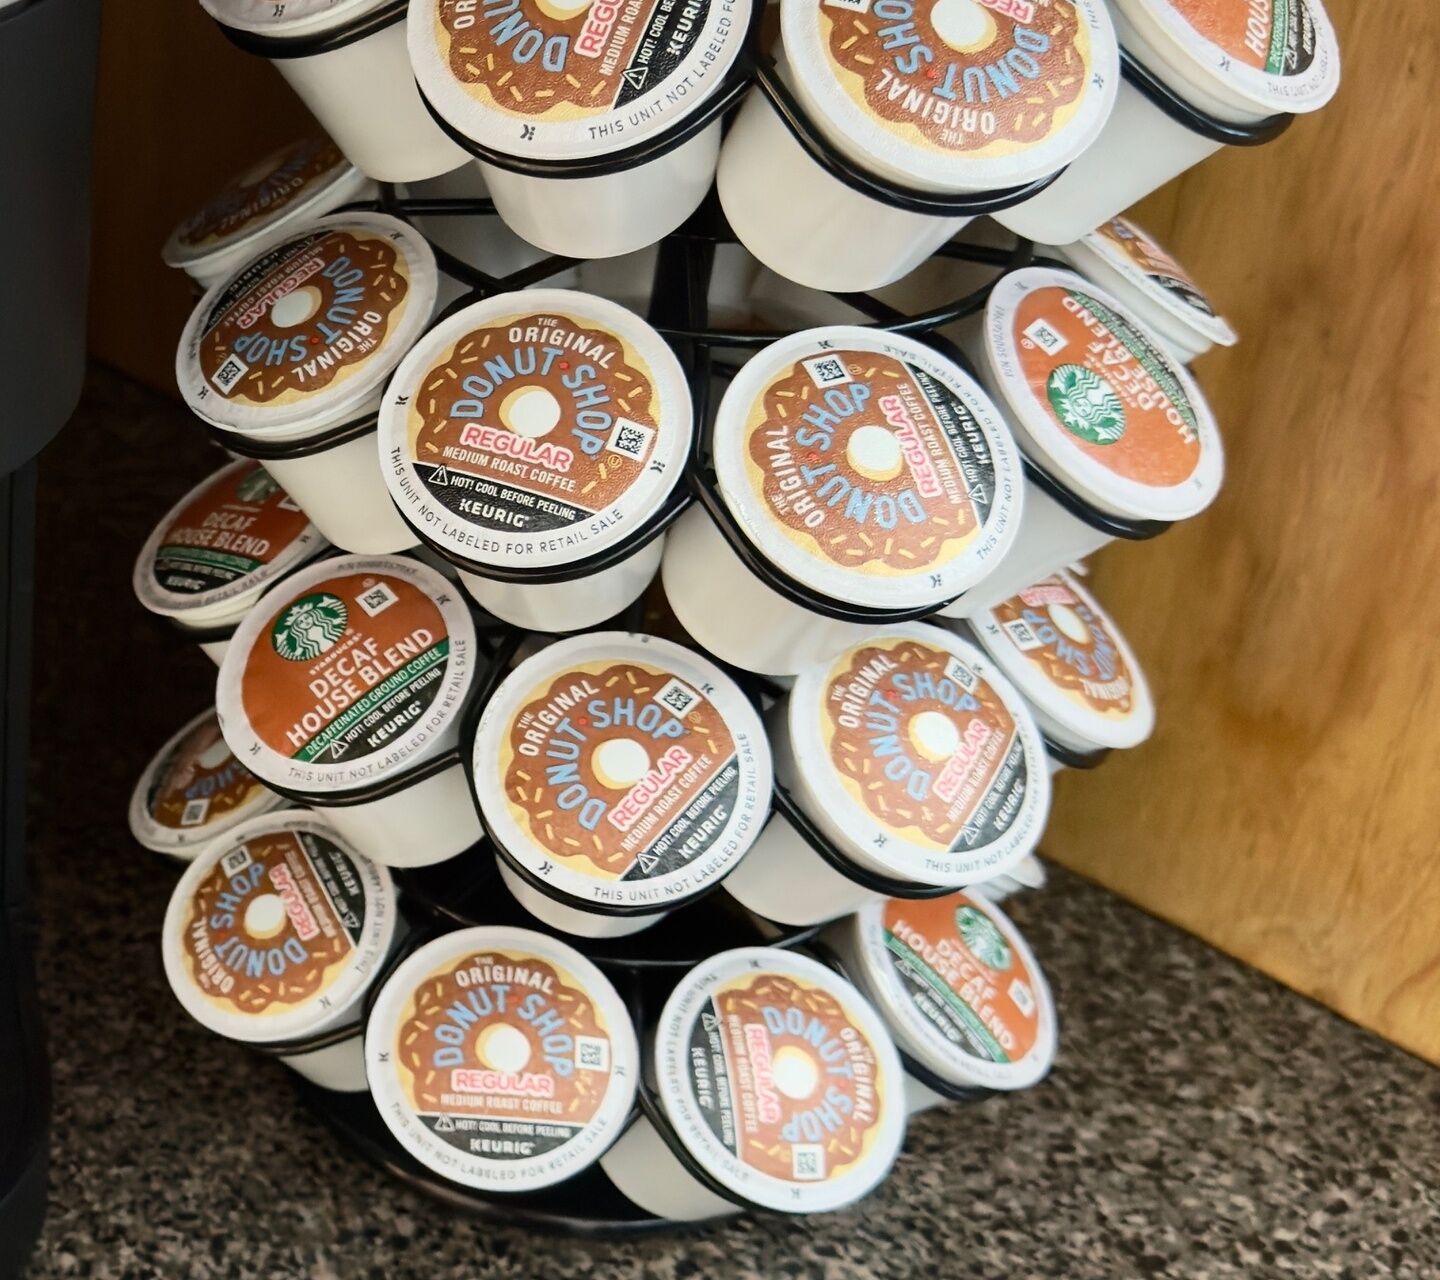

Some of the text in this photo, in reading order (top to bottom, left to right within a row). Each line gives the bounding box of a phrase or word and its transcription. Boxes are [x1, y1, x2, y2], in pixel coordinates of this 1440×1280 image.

[600, 23, 630, 76] MEDIUM
[636, 40, 652, 65] HOT!
[649, 8, 669, 38] COOL
[932, 25, 1051, 103] DONUT
[588, 121, 624, 140] THIS
[629, 99, 662, 126] UNIT
[668, 77, 692, 104] NOT
[697, 15, 732, 79] LABELED
[874, 69, 997, 135] ORIGINAL
[940, 129, 963, 144] THE
[237, 257, 325, 329] REGULAR
[316, 256, 366, 346] DONUT
[538, 317, 558, 328] THE
[234, 331, 308, 366] SHOP
[291, 310, 382, 383] ORIGINAL
[359, 337, 378, 354] THE
[509, 327, 617, 369] ORIGINAL
[1063, 296, 1134, 362] BLEND
[449, 346, 614, 456] DONUT SHOP
[1088, 341, 1155, 410] DECAF
[1132, 364, 1196, 444] HOUSE
[460, 423, 574, 473] REGULAR
[795, 382, 928, 529] DONUT SHOP
[878, 395, 944, 498] REGULAR
[896, 384, 961, 504] MEDIUM ROAST COFFEE
[950, 400, 990, 465] KEURIG
[390, 446, 624, 554] THIS UNIT NOT LABELED FOR RETAIL SALE
[443, 445, 576, 493] MEDIUM ROAST COFFEE
[450, 475, 576, 521] HOT! COOL BEFORE PEELING
[766, 425, 826, 528] ORIGINAL
[770, 492, 791, 516] THE
[214, 532, 270, 556] BLEND
[459, 499, 530, 528] KEURIG
[286, 628, 433, 748] HOUSE BLEND
[309, 637, 378, 699] DECAF
[310, 633, 362, 675] STARBUCKS
[289, 639, 465, 782] THIS UNIT NOT LABELED FOR RETAIL SALE
[306, 648, 441, 755] DECAFFEINATED GROUND COFFEE
[364, 710, 384, 728] COOL
[383, 690, 410, 712] BEFORE
[410, 668, 441, 691] PEELING
[367, 701, 420, 747] KEURIG
[517, 711, 533, 730] THE
[520, 680, 600, 756] ORIGINAL
[838, 654, 898, 728] ORIGINAL
[546, 698, 686, 831] DONUT SHOP
[863, 672, 980, 801] DONUT SHOP
[932, 718, 990, 803] REGULAR
[594, 732, 758, 900] THIS UNIT NOT LABELED FOR RETAIL SALE
[608, 745, 692, 831] REGULAR
[621, 754, 711, 852] MEDIUM ROAST COFFEE
[671, 814, 690, 838] COOL
[685, 790, 712, 819] BEFORE
[709, 766, 738, 796] PEELING
[678, 804, 726, 859] KEURIG
[210, 863, 264, 929] SHOP
[192, 916, 234, 993] ORIGINAL
[214, 937, 307, 977] DONUT
[455, 964, 554, 994] ORIGINAL
[892, 920, 960, 984] HOUSE
[960, 984, 1016, 1051] BLEND
[936, 939, 998, 1001] DECAF
[434, 985, 574, 1076] DONUT SHOP
[451, 1070, 555, 1097] REGULAR
[691, 1047, 713, 1109] KEURIG
[743, 1023, 780, 1124] REGULAR
[762, 1006, 854, 1143] DONUT SHOP
[840, 1028, 875, 1121] ORIGINAL
[470, 1139, 536, 1155] KEURIG
